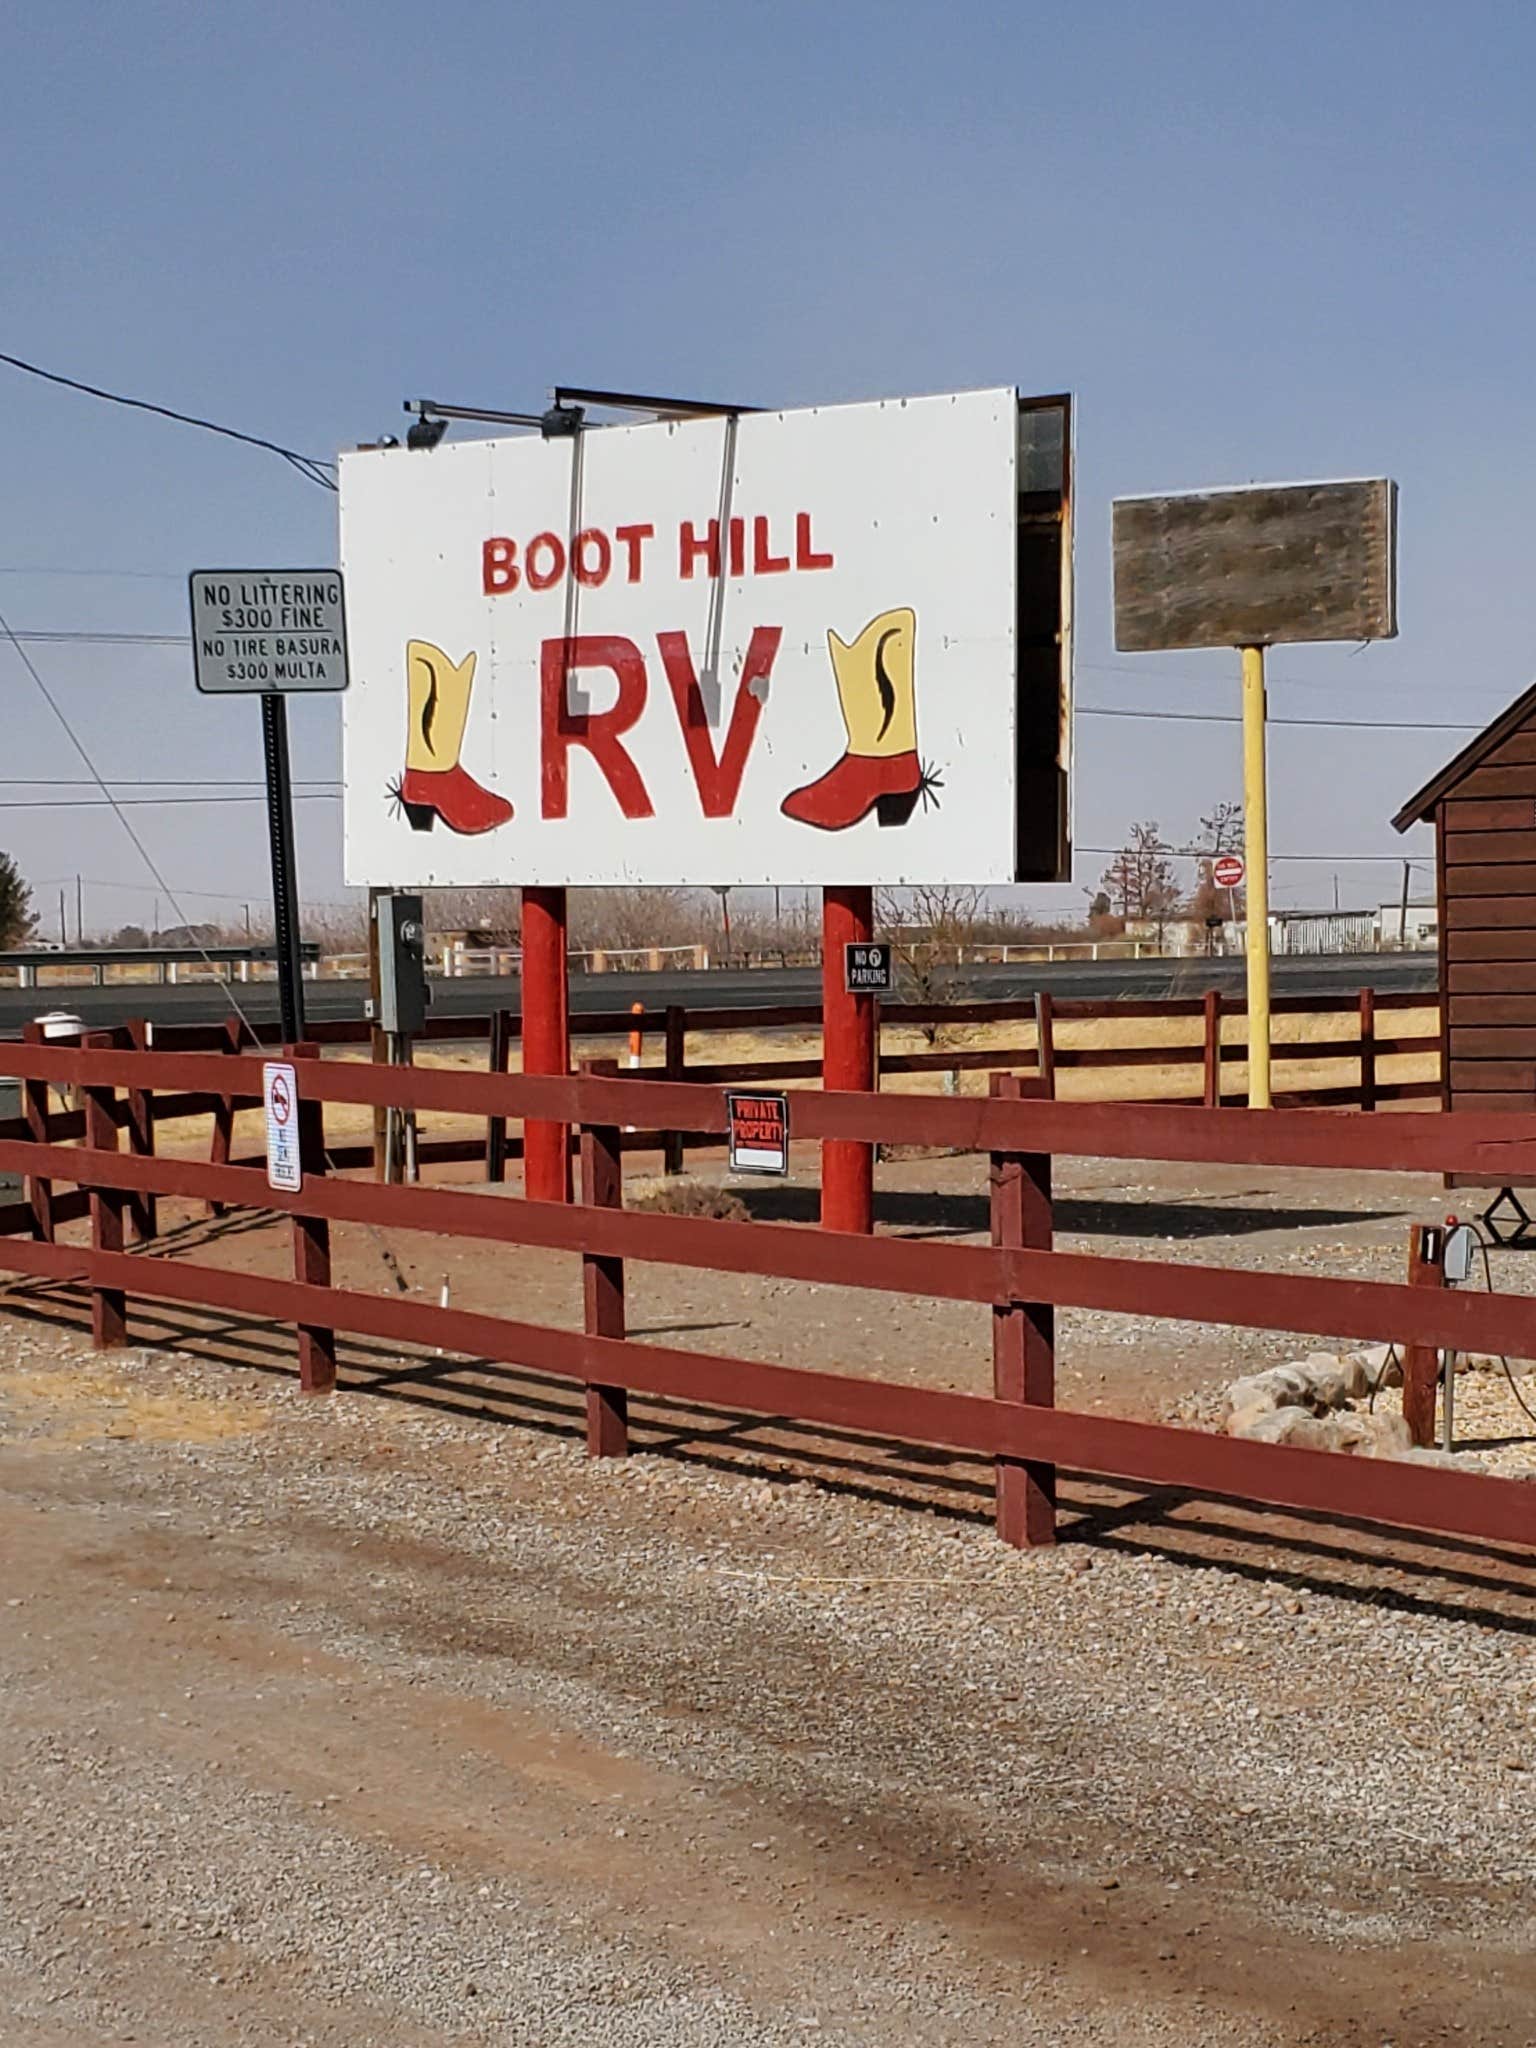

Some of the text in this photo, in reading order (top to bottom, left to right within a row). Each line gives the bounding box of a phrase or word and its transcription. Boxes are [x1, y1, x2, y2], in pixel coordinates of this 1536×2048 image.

[482, 512, 834, 597] BOOT HILL
[204, 584, 338, 606] NO LITTERING
[222, 607, 324, 628] $300 FINE
[203, 639, 341, 656] NO TIRE BASURA
[226, 661, 326, 679] $300 MULTA
[540, 626, 783, 820] RV
[1426, 1231, 1434, 1260] 1
